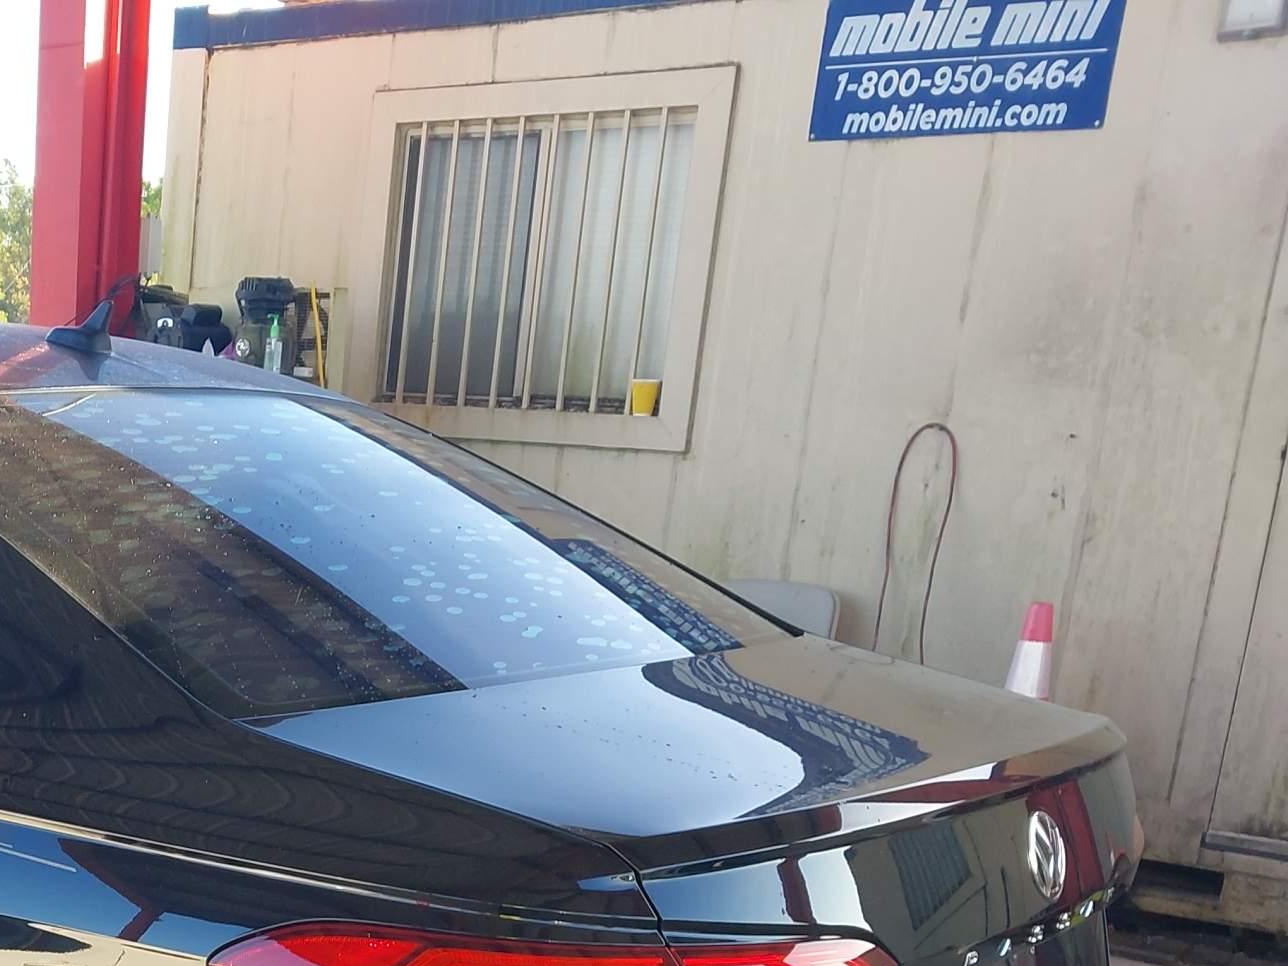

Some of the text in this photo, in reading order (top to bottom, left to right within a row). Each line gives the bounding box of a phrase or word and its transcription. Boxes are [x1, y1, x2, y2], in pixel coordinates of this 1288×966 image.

[829, 0, 1110, 57] mobile mini
[834, 57, 1090, 100] 1-800-950-6464
[842, 100, 1068, 134] mobilemini.com
